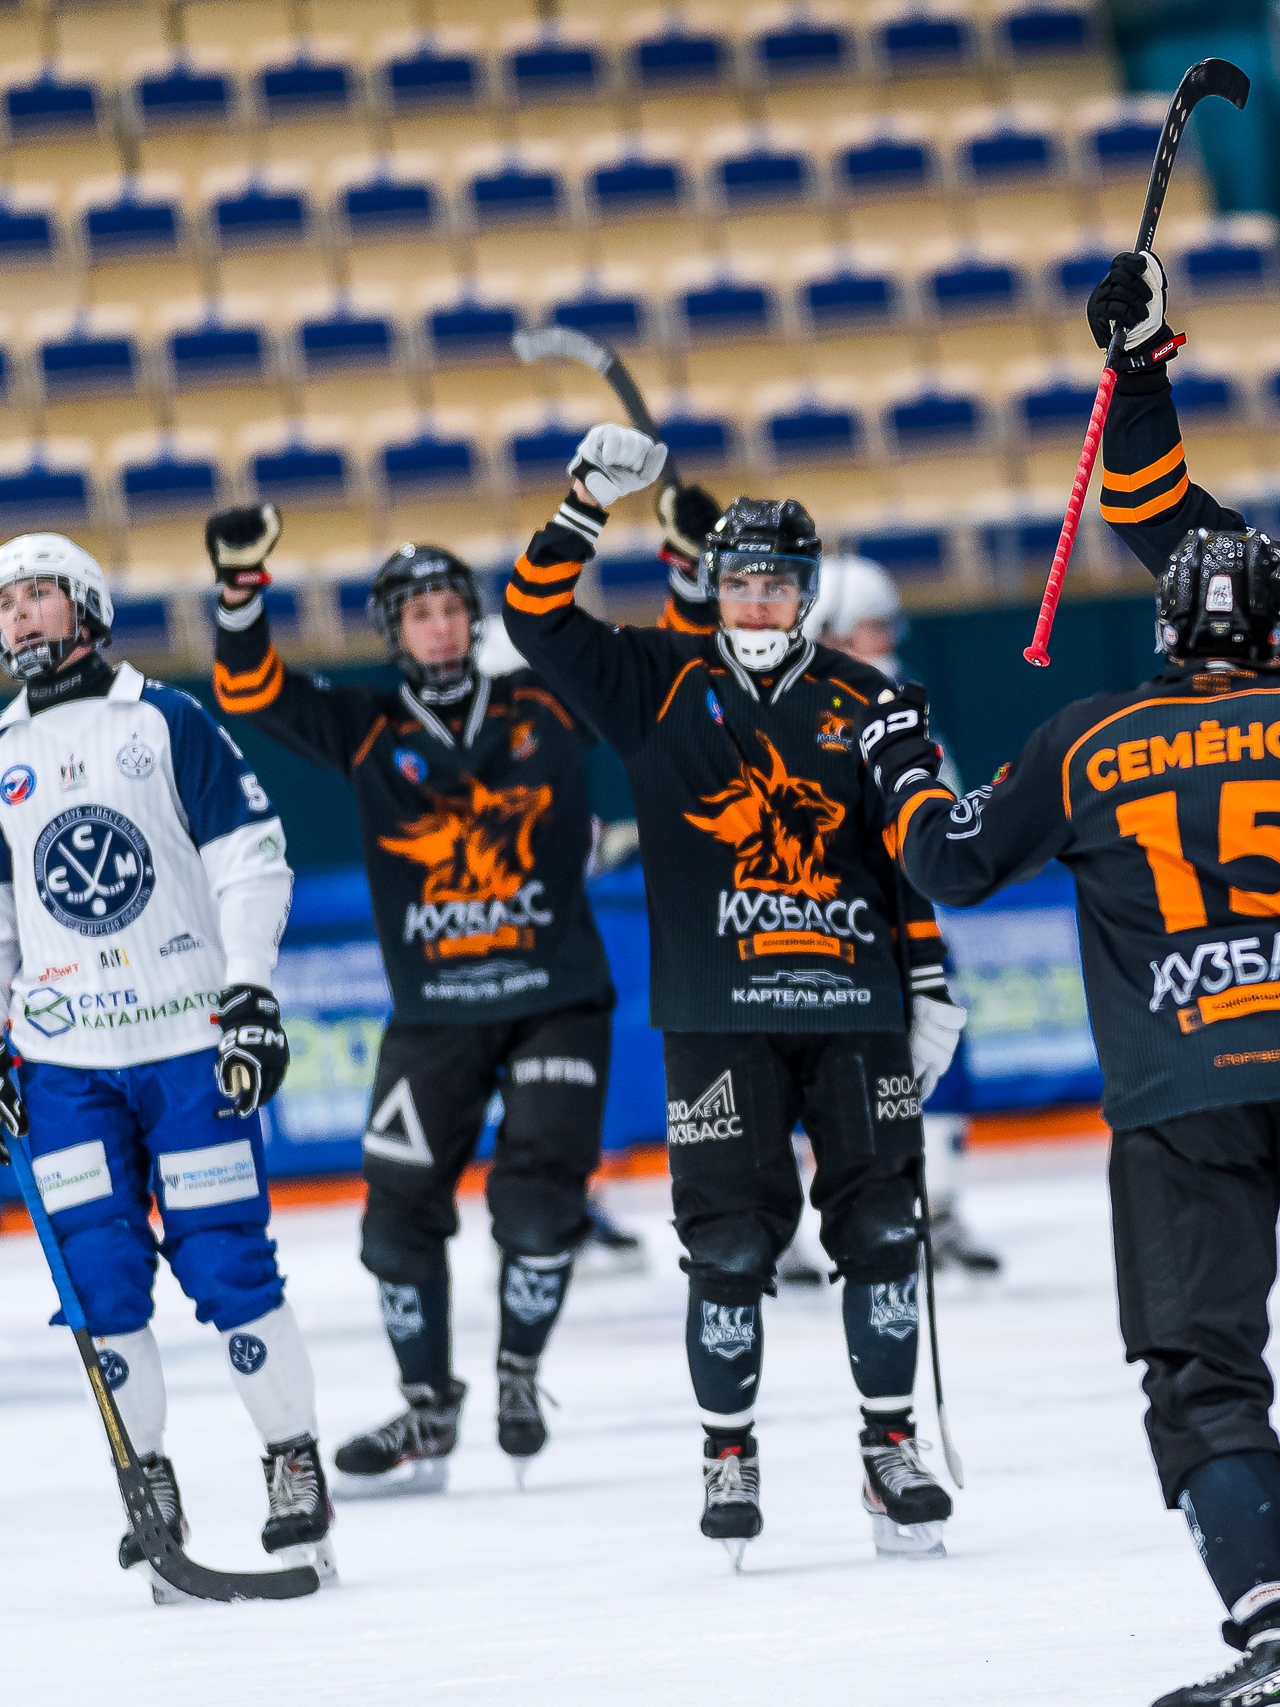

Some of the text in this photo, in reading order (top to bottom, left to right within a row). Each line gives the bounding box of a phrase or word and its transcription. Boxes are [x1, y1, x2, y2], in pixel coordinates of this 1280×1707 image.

[1153, 341, 1174, 359] CCM
[716, 889, 875, 943] КУЗБАСС
[78, 988, 139, 1010] СКТБ
[732, 988, 872, 1004] КАРТЕЛЬ АВТО
[219, 1025, 285, 1050] CCM
[878, 1075, 911, 1097] 300
[667, 1100, 689, 1122] 300
[877, 1097, 920, 1120] КУЗБ
